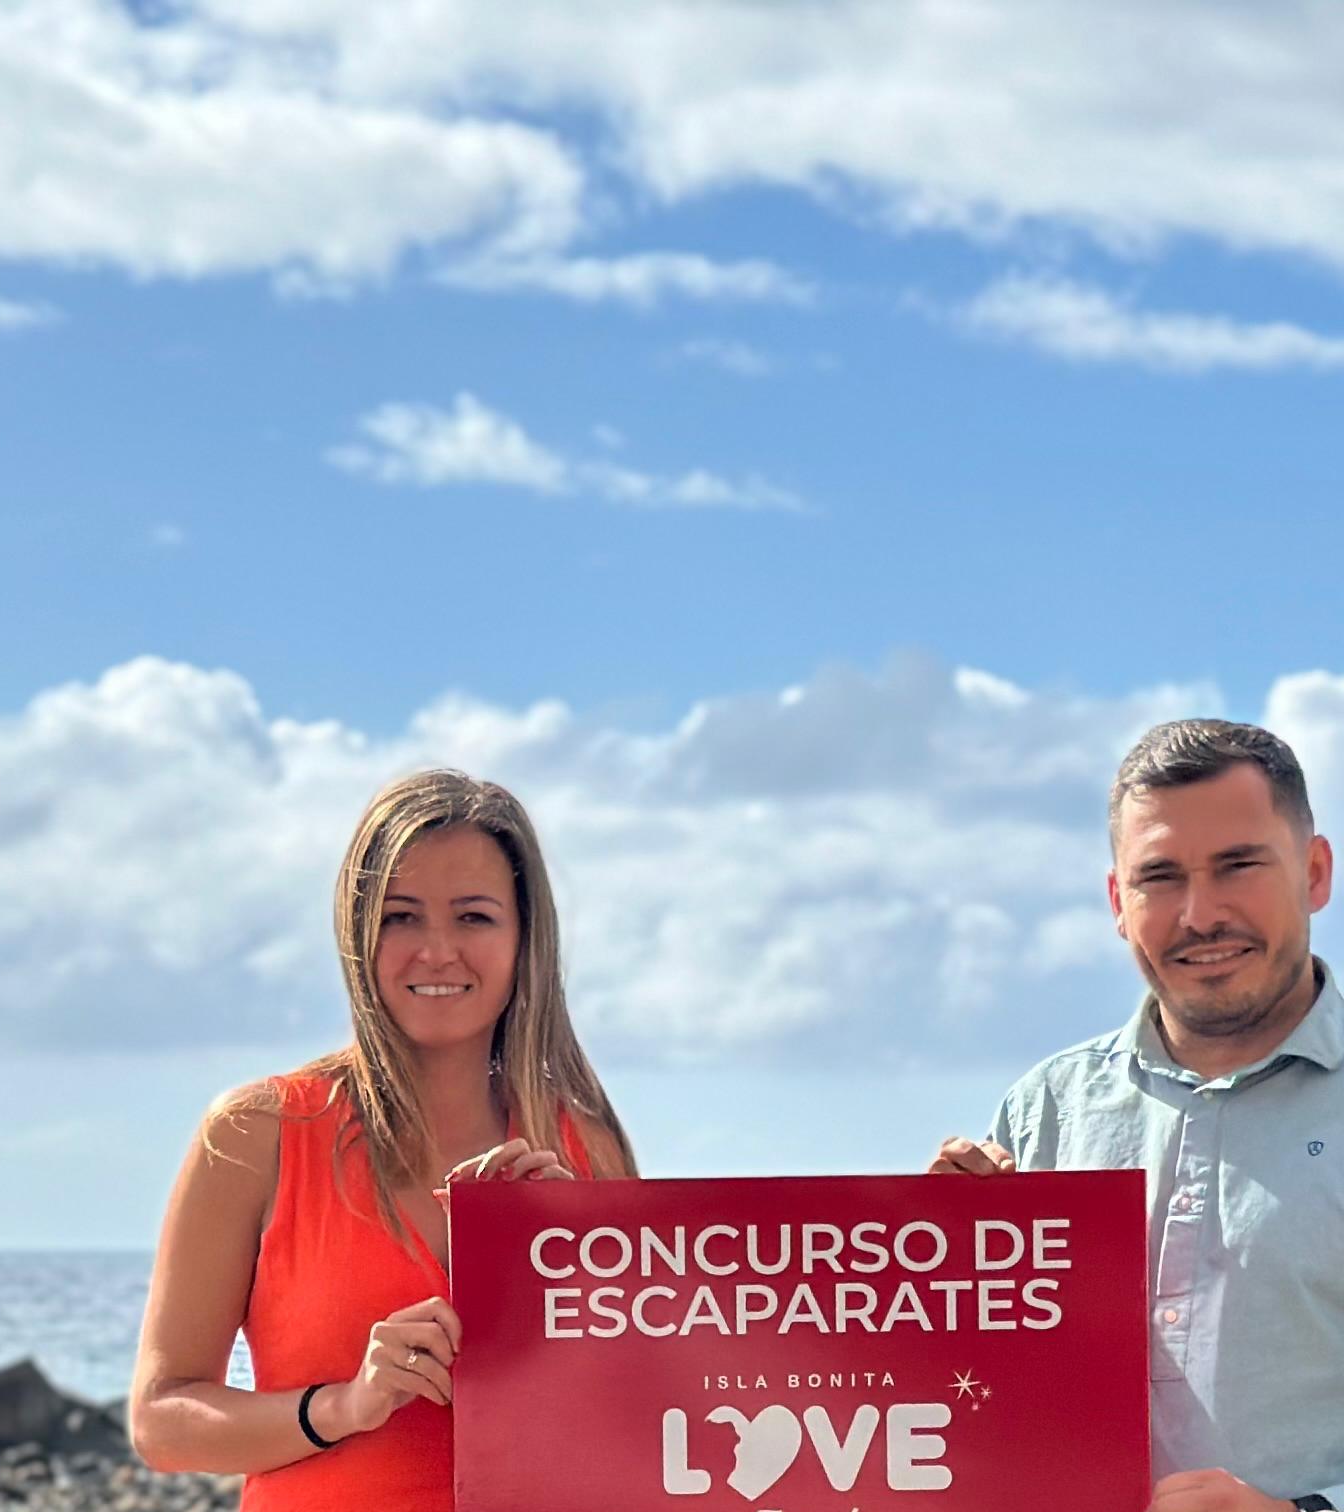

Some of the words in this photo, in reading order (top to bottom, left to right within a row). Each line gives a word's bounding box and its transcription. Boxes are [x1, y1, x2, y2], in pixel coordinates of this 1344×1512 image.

[530, 1221, 947, 1279] CONCURSO
[975, 1218, 1072, 1271] DE
[542, 1278, 1063, 1339] ESCAPARATES
[704, 1374, 768, 1390] ISLA
[787, 1372, 895, 1389] BONITA
[662, 1402, 953, 1502] LOVE
